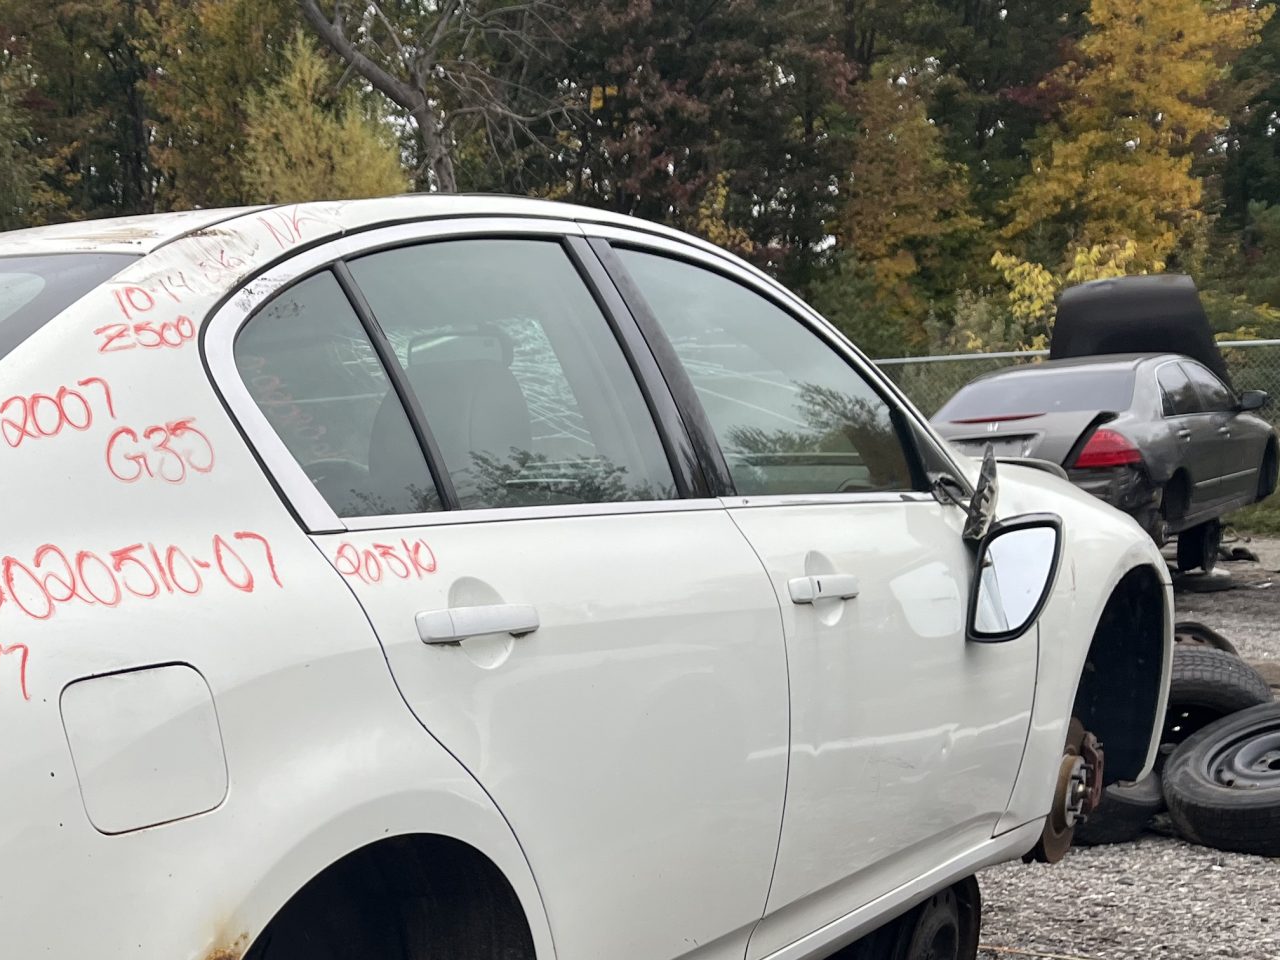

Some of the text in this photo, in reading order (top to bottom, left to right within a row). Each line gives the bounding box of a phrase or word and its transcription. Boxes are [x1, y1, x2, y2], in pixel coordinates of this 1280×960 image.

[0, 376, 118, 455] 2007
[106, 412, 214, 482] G35
[336, 540, 437, 581] 20510
